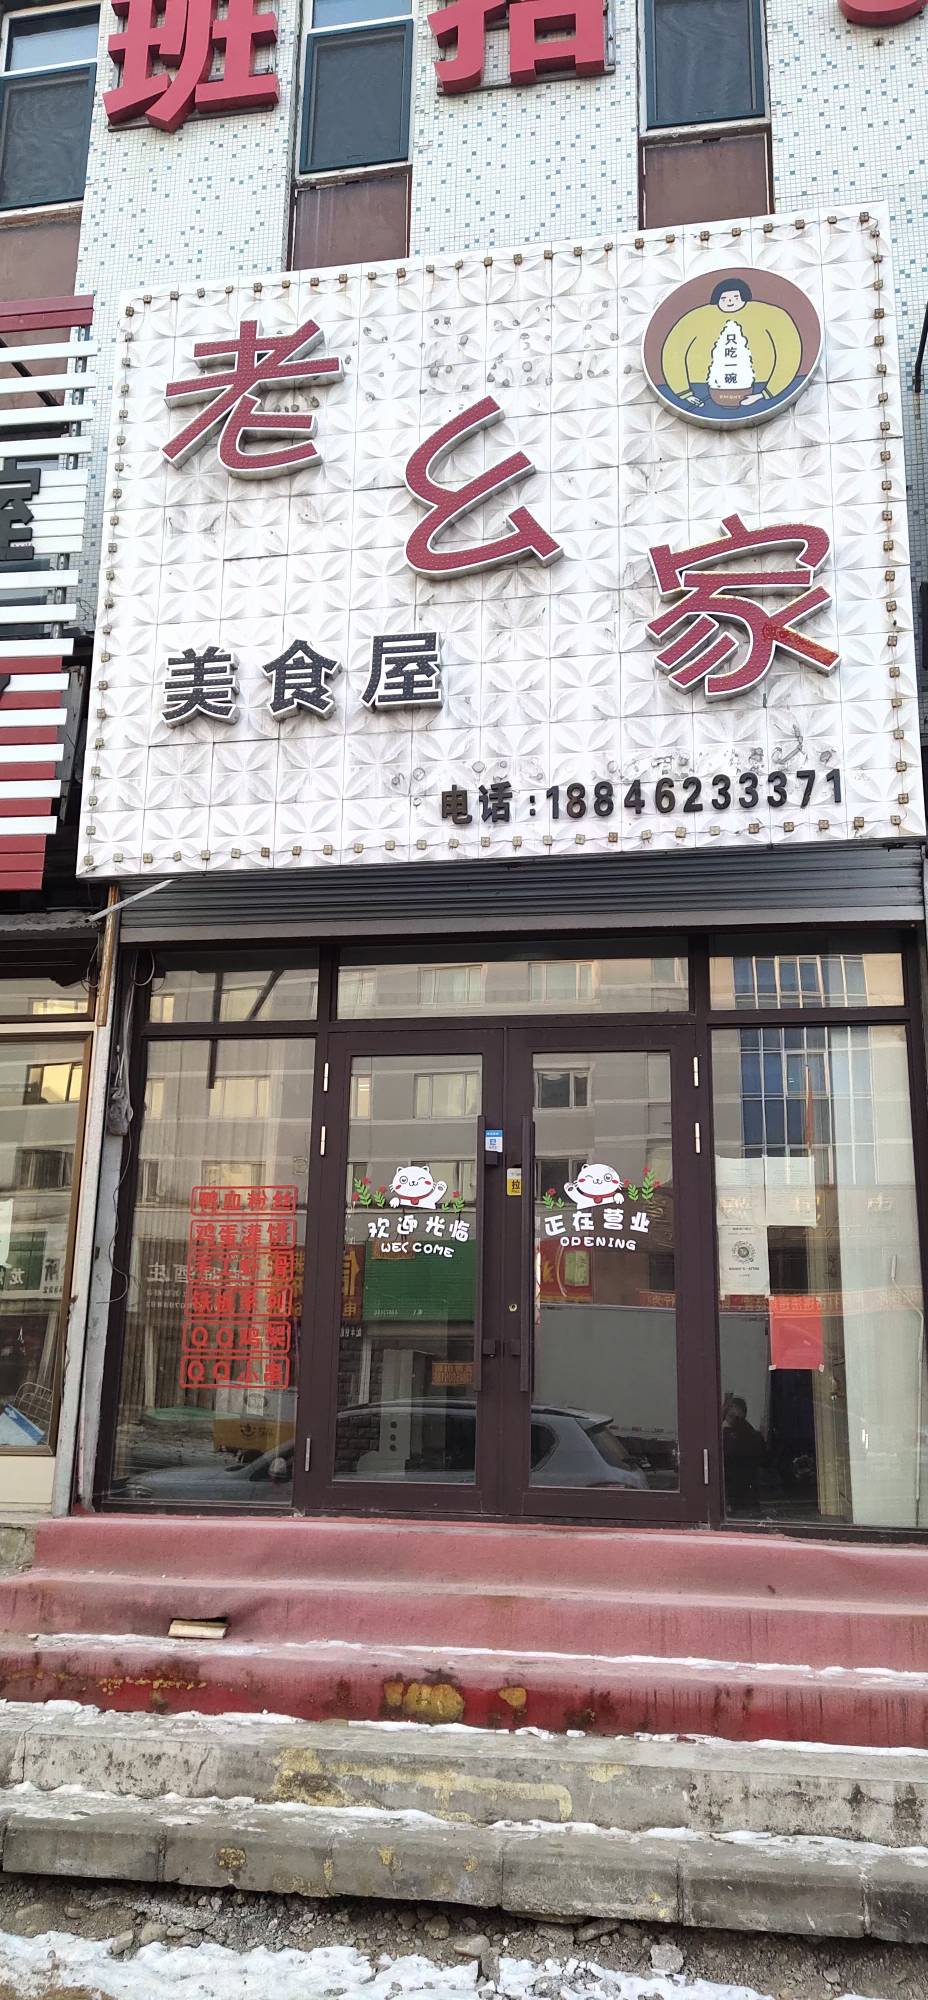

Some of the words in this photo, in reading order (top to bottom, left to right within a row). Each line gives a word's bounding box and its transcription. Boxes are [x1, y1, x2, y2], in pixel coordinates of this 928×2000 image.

[724, 333, 738, 384] 只吃一碗
[163, 631, 444, 730] 美食屋
[367, 1214, 470, 1242] 欢迎光临
[544, 1208, 650, 1236] 正在营业
[187, 1359, 283, 1384] QQ小串
